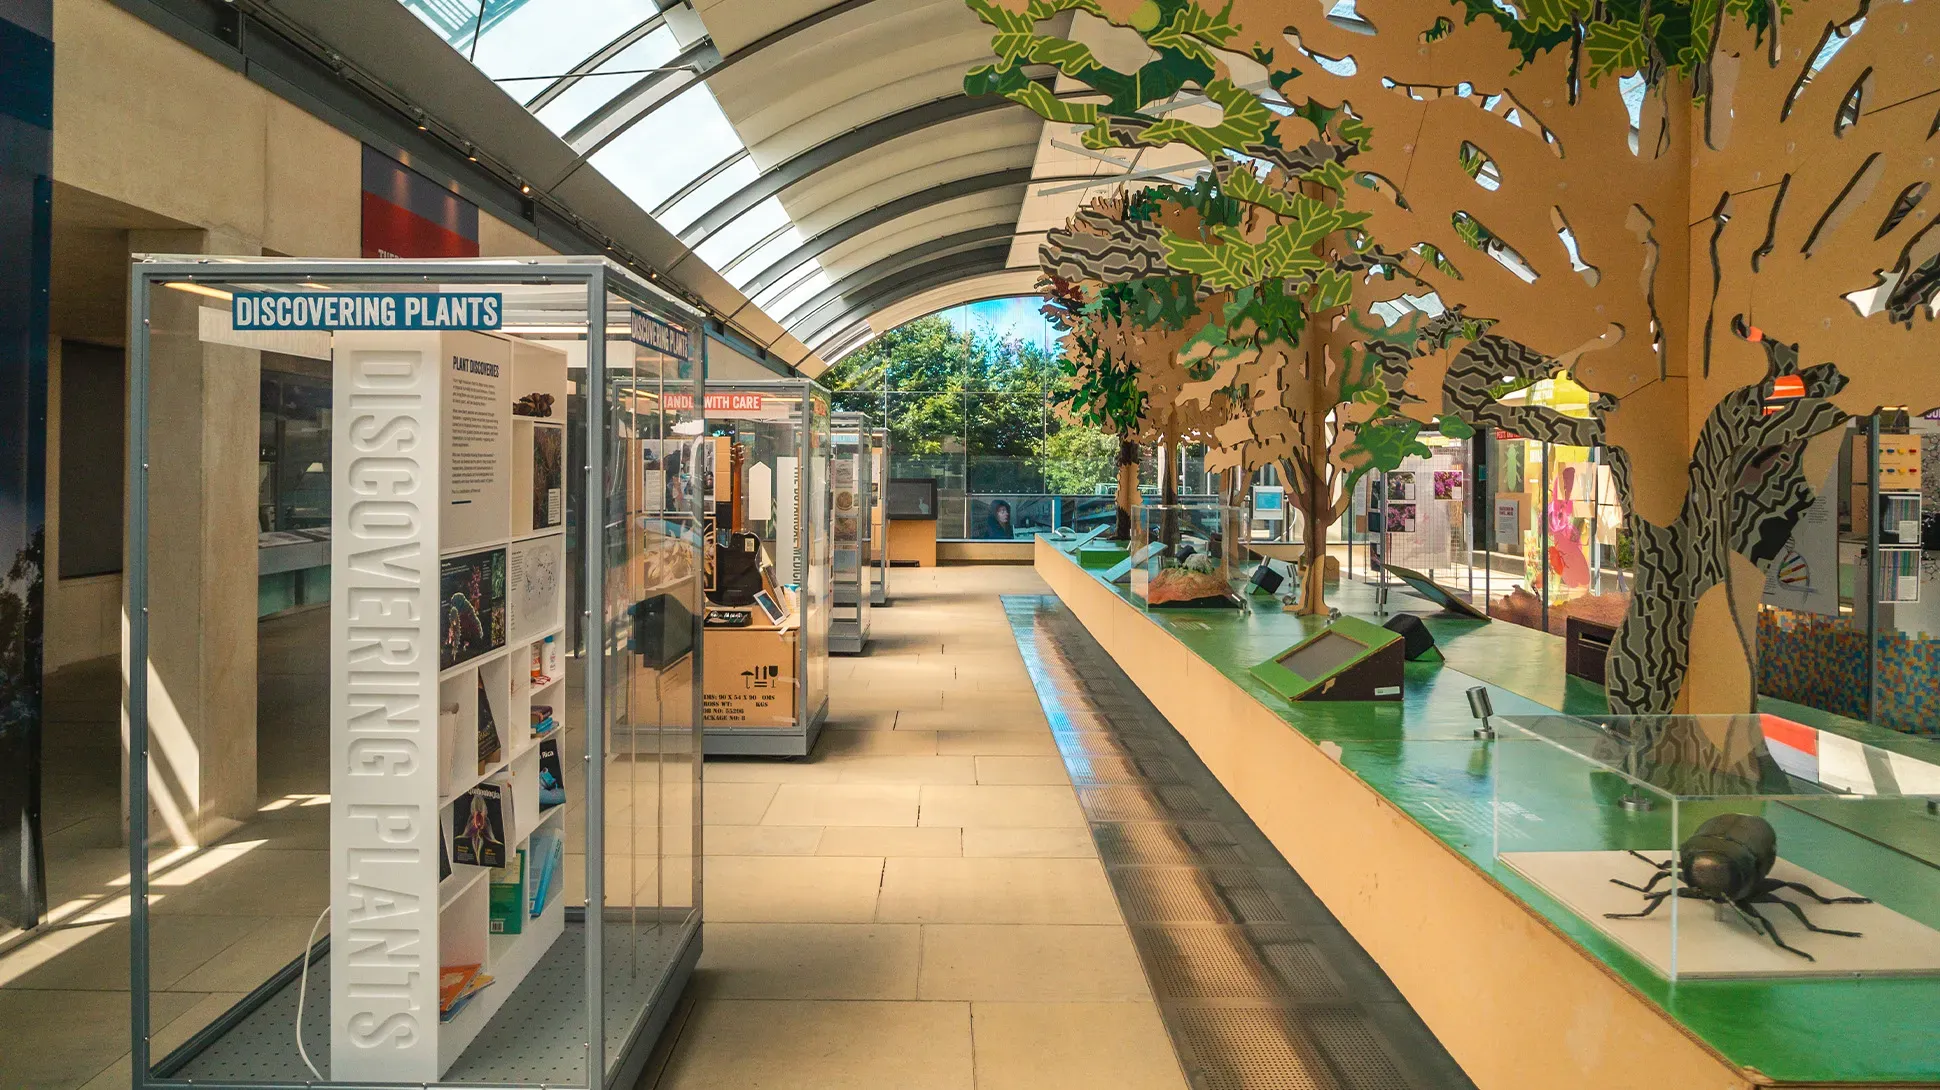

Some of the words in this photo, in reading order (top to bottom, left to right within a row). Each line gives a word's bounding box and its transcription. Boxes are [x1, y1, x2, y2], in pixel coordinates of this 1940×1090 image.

[236, 296, 396, 327] DISCOVERING
[404, 296, 498, 327] PLANTS
[631, 311, 669, 351] DISCOVERING
[669, 329, 688, 358] PLANTS
[452, 356, 469, 372] PLANT
[469, 360, 500, 378] DISCOVERIES
[704, 395, 730, 409] WITH
[732, 395, 760, 409] CARE
[347, 349, 423, 778] DISCOVERING
[346, 803, 420, 1050] PLANTS
